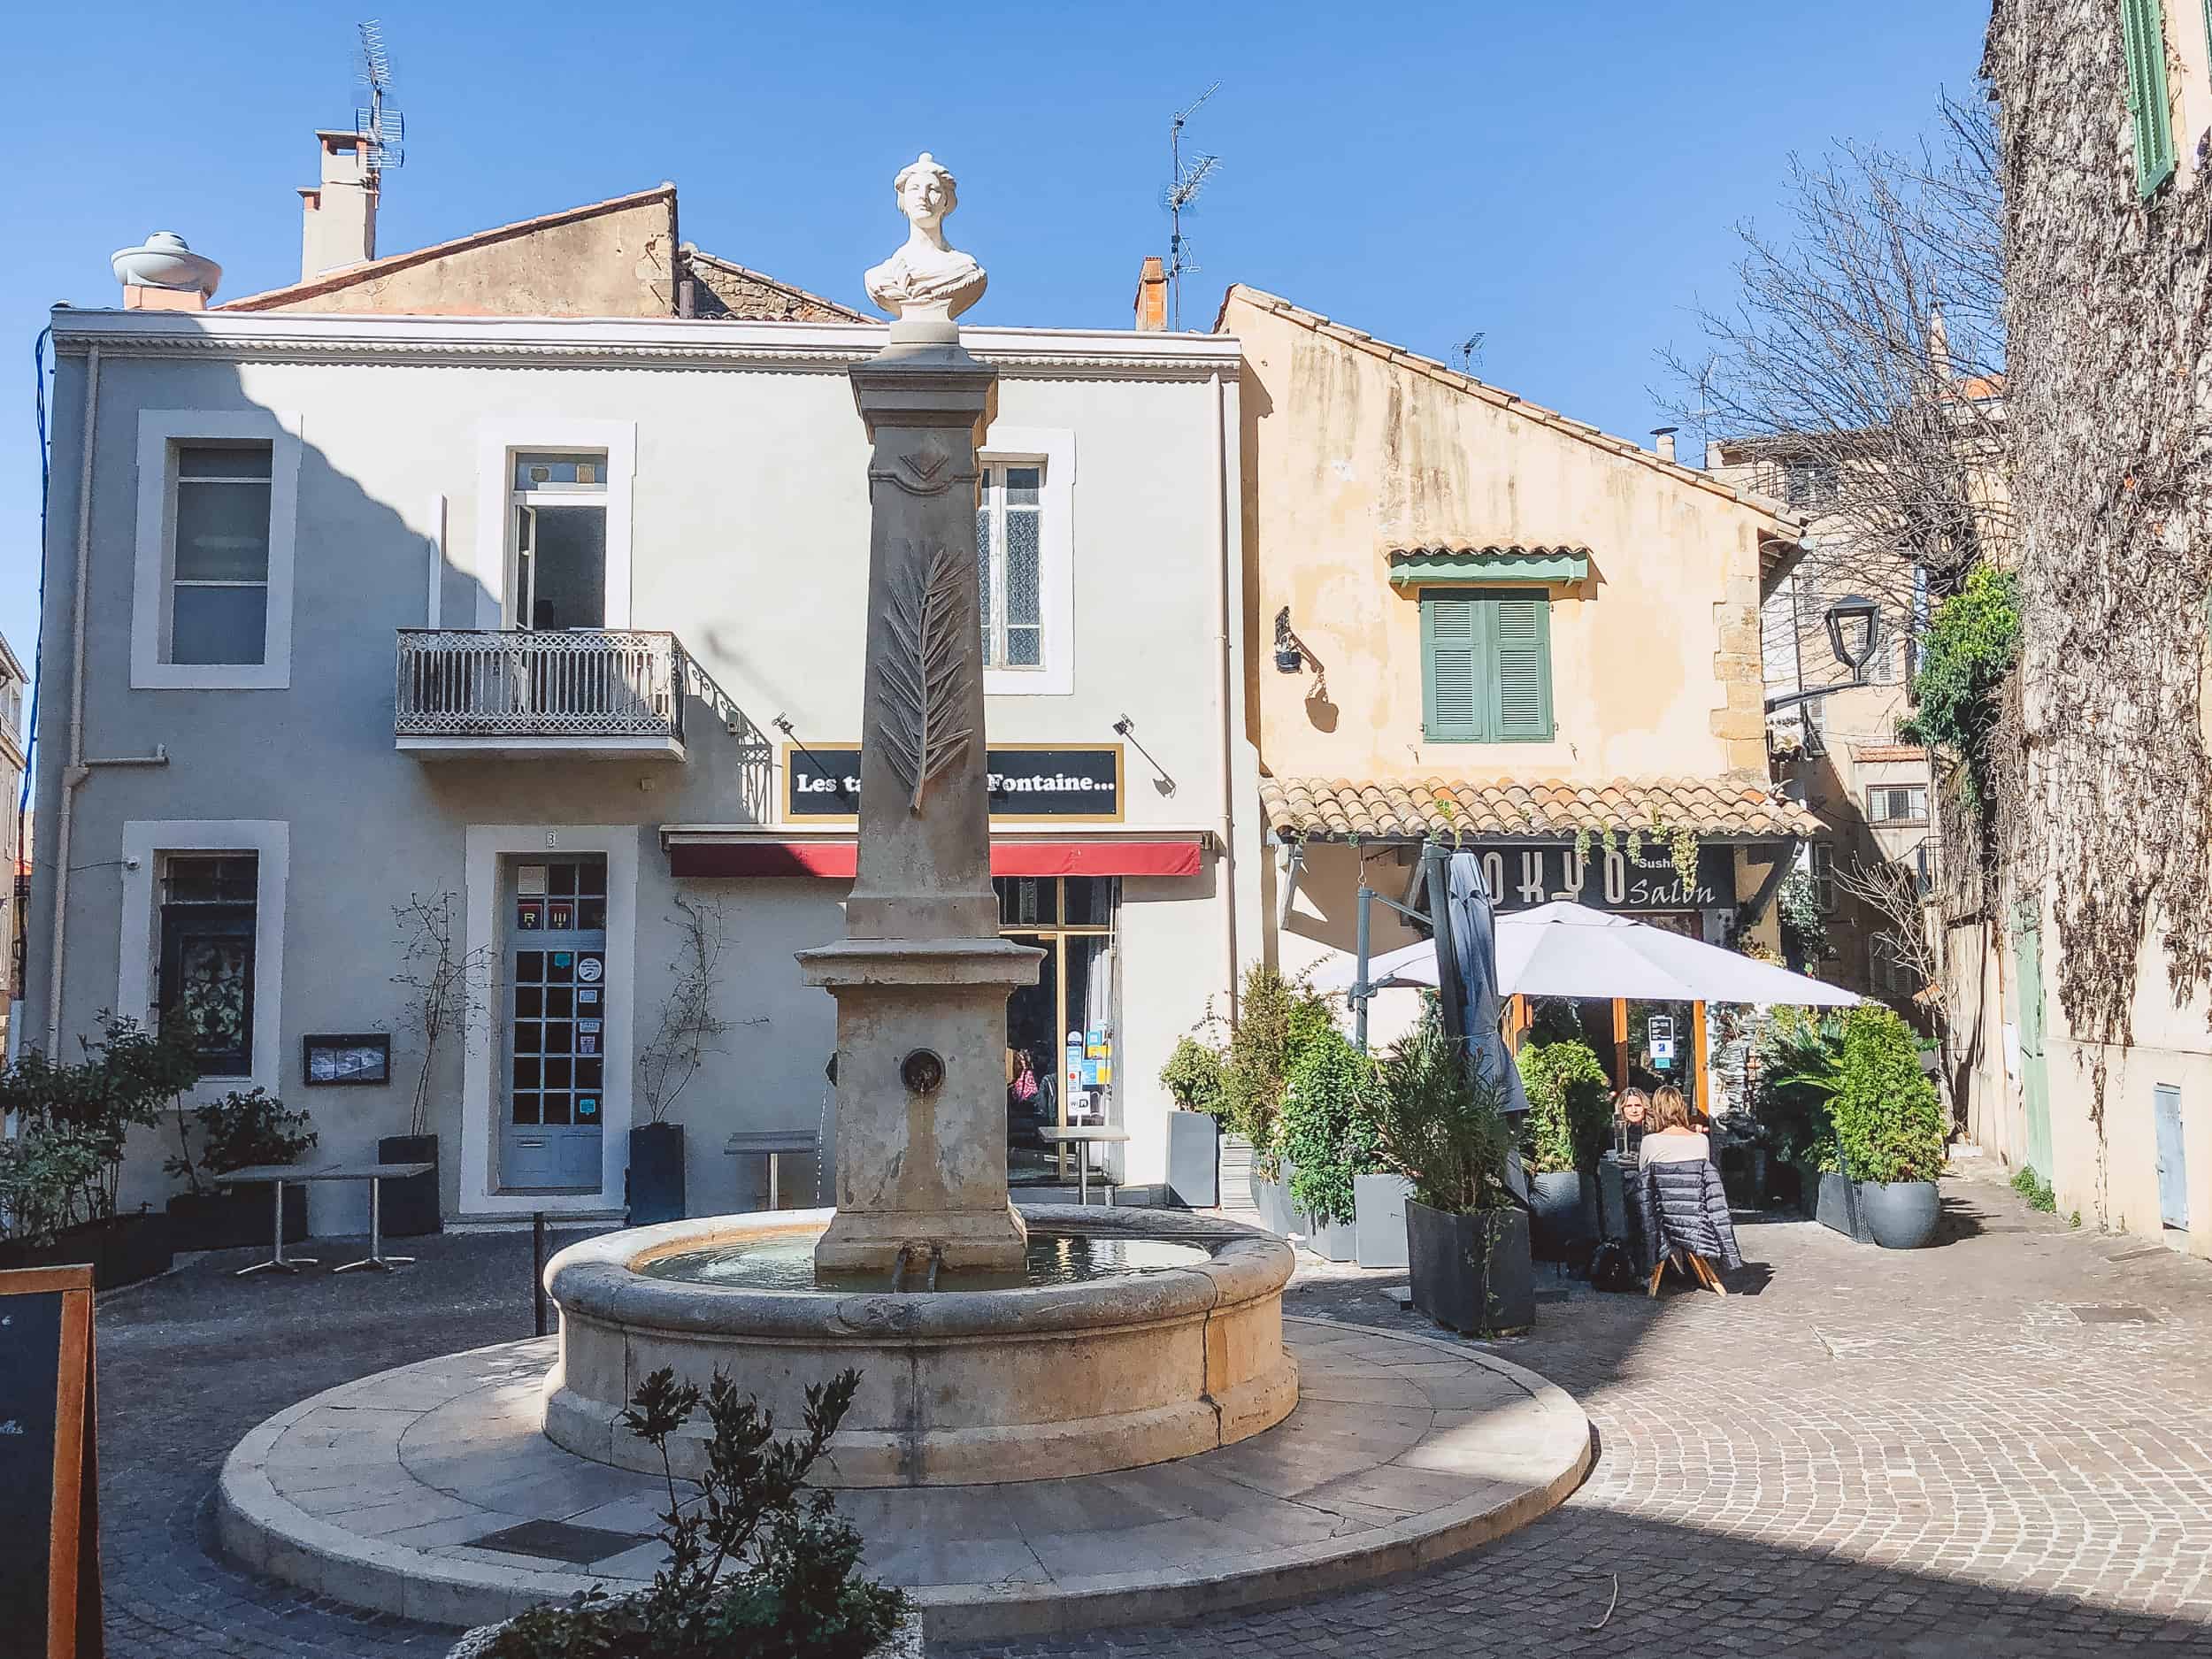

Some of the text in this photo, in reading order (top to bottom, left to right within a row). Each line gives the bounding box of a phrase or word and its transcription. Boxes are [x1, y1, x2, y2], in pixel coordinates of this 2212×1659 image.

[796, 773, 837, 793] Les
[987, 773, 1115, 792] Fontaine...
[1483, 851, 1625, 904] OKYO
[1629, 878, 1716, 904] Salon
